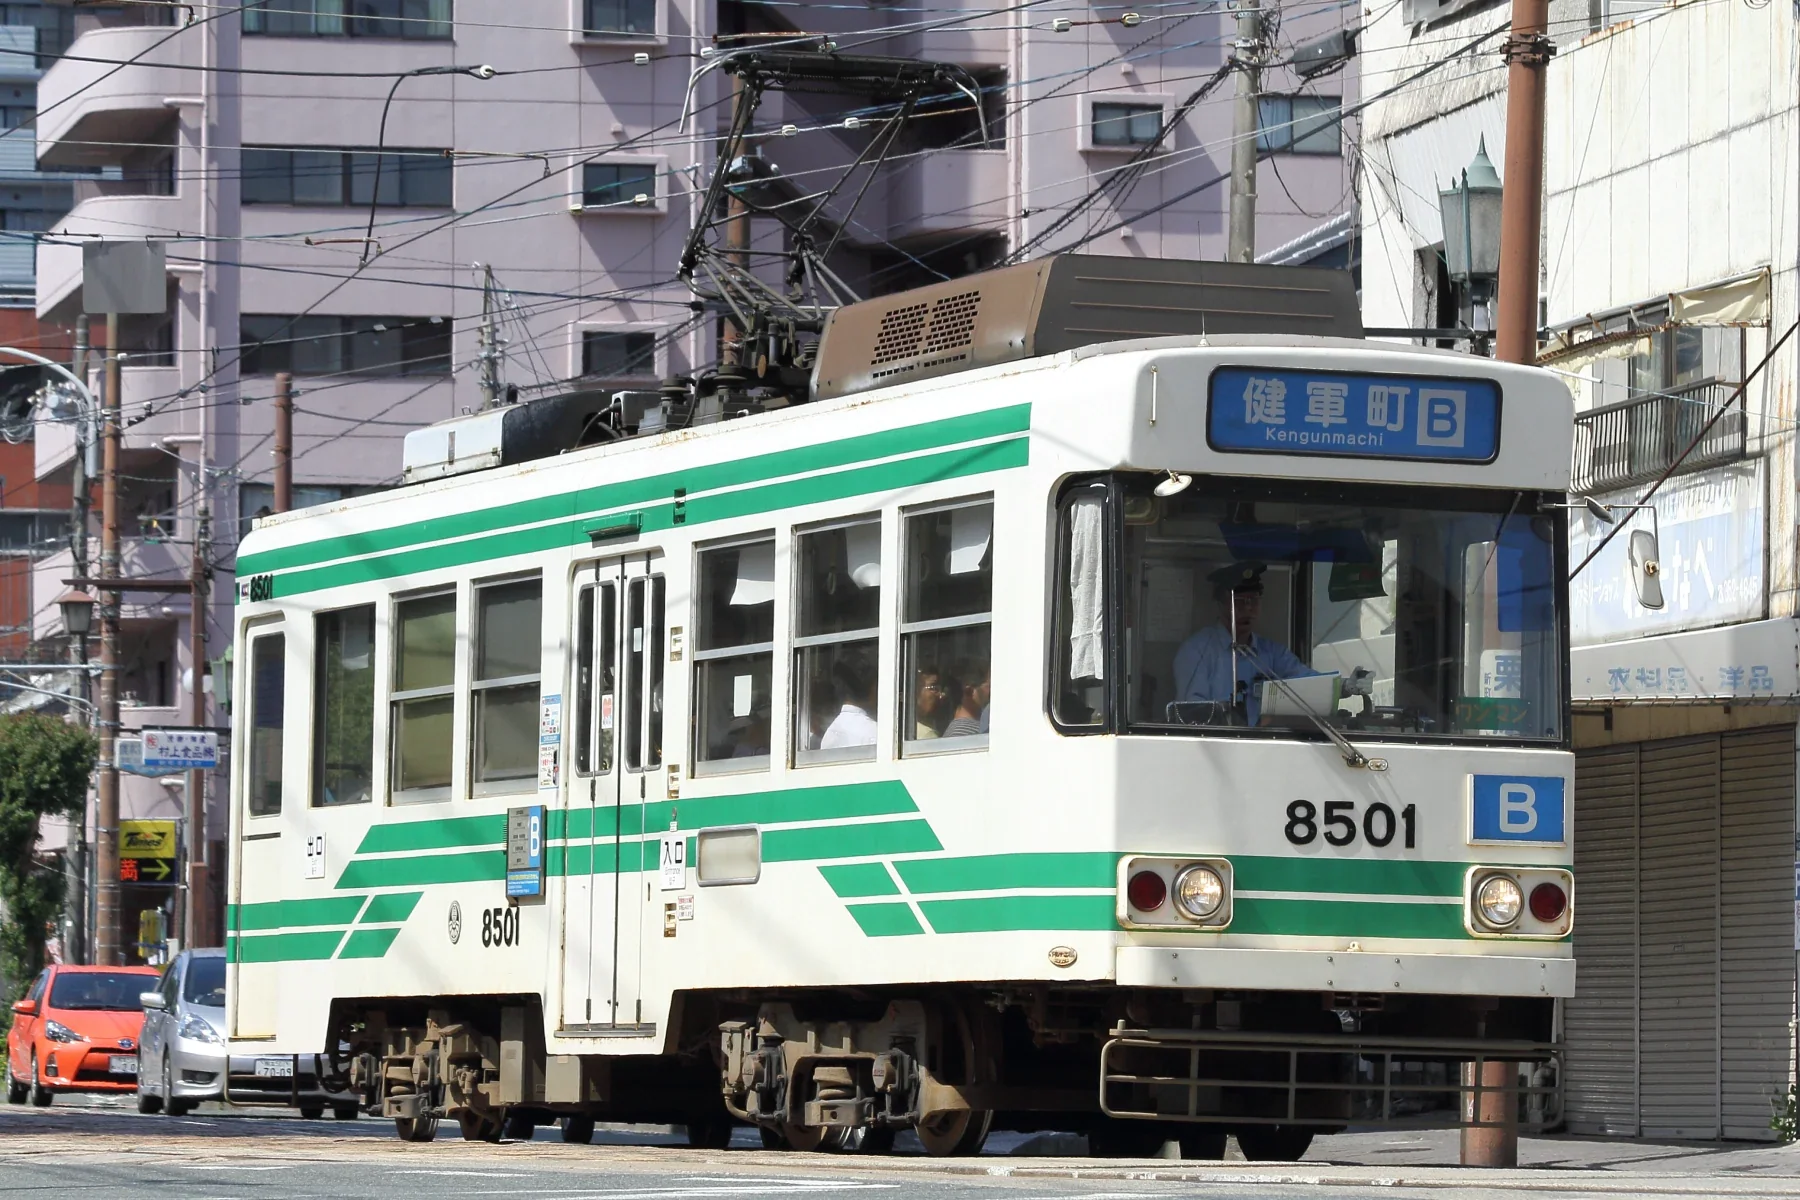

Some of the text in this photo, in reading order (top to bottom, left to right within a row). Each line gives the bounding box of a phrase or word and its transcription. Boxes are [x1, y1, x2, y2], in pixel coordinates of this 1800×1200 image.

[1242, 377, 1461, 441] 健軍町 B
[1265, 427, 1384, 446] Kengunmachi
[251, 573, 273, 602] 8501
[1455, 704, 1528, 723] ワンマン
[1284, 799, 1416, 848] 8501
[1499, 783, 1538, 833] B
[307, 836, 322, 856] 出口
[530, 815, 540, 857] B
[663, 841, 683, 865] 入口
[482, 906, 520, 948] 8501
